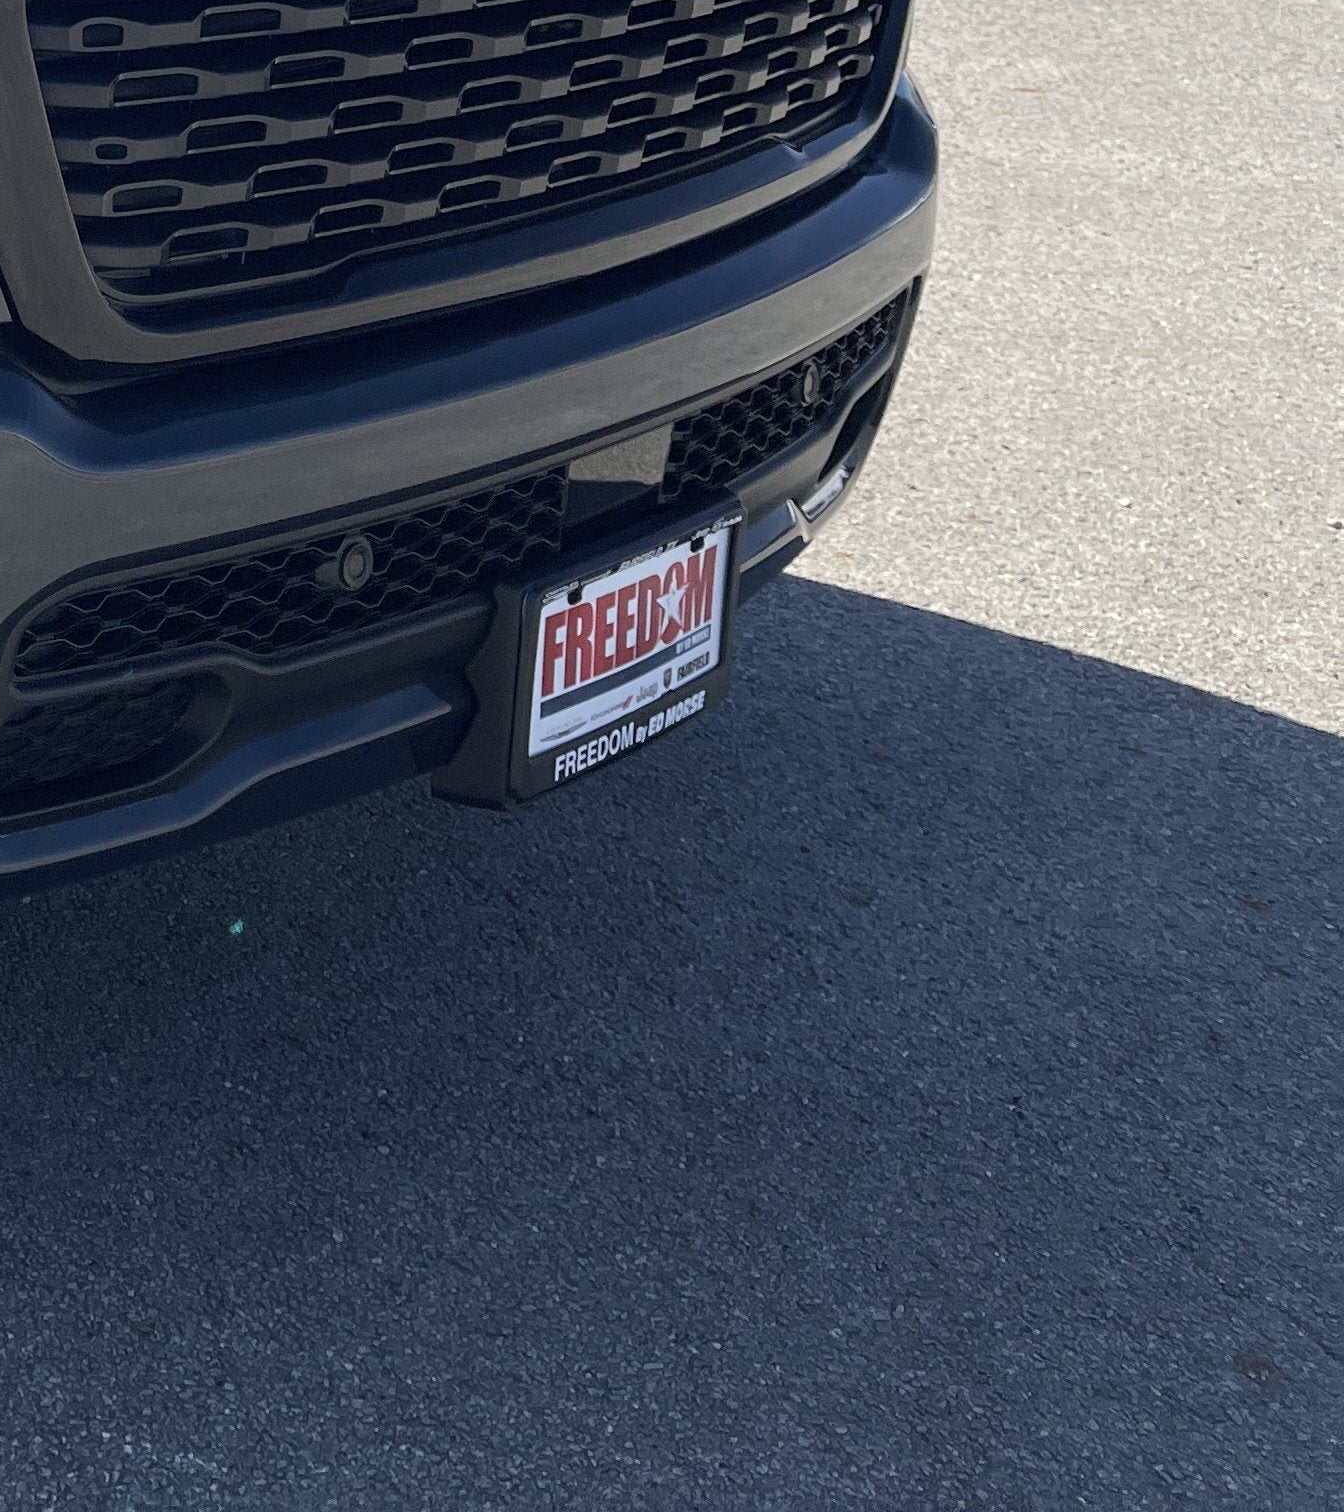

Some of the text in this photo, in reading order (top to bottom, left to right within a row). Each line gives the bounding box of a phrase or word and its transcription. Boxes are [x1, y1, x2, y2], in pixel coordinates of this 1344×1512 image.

[541, 544, 718, 698] FREEDOM
[554, 721, 635, 782] FREEDOM
[648, 711, 664, 736] ED
[664, 690, 706, 728] MORSE
